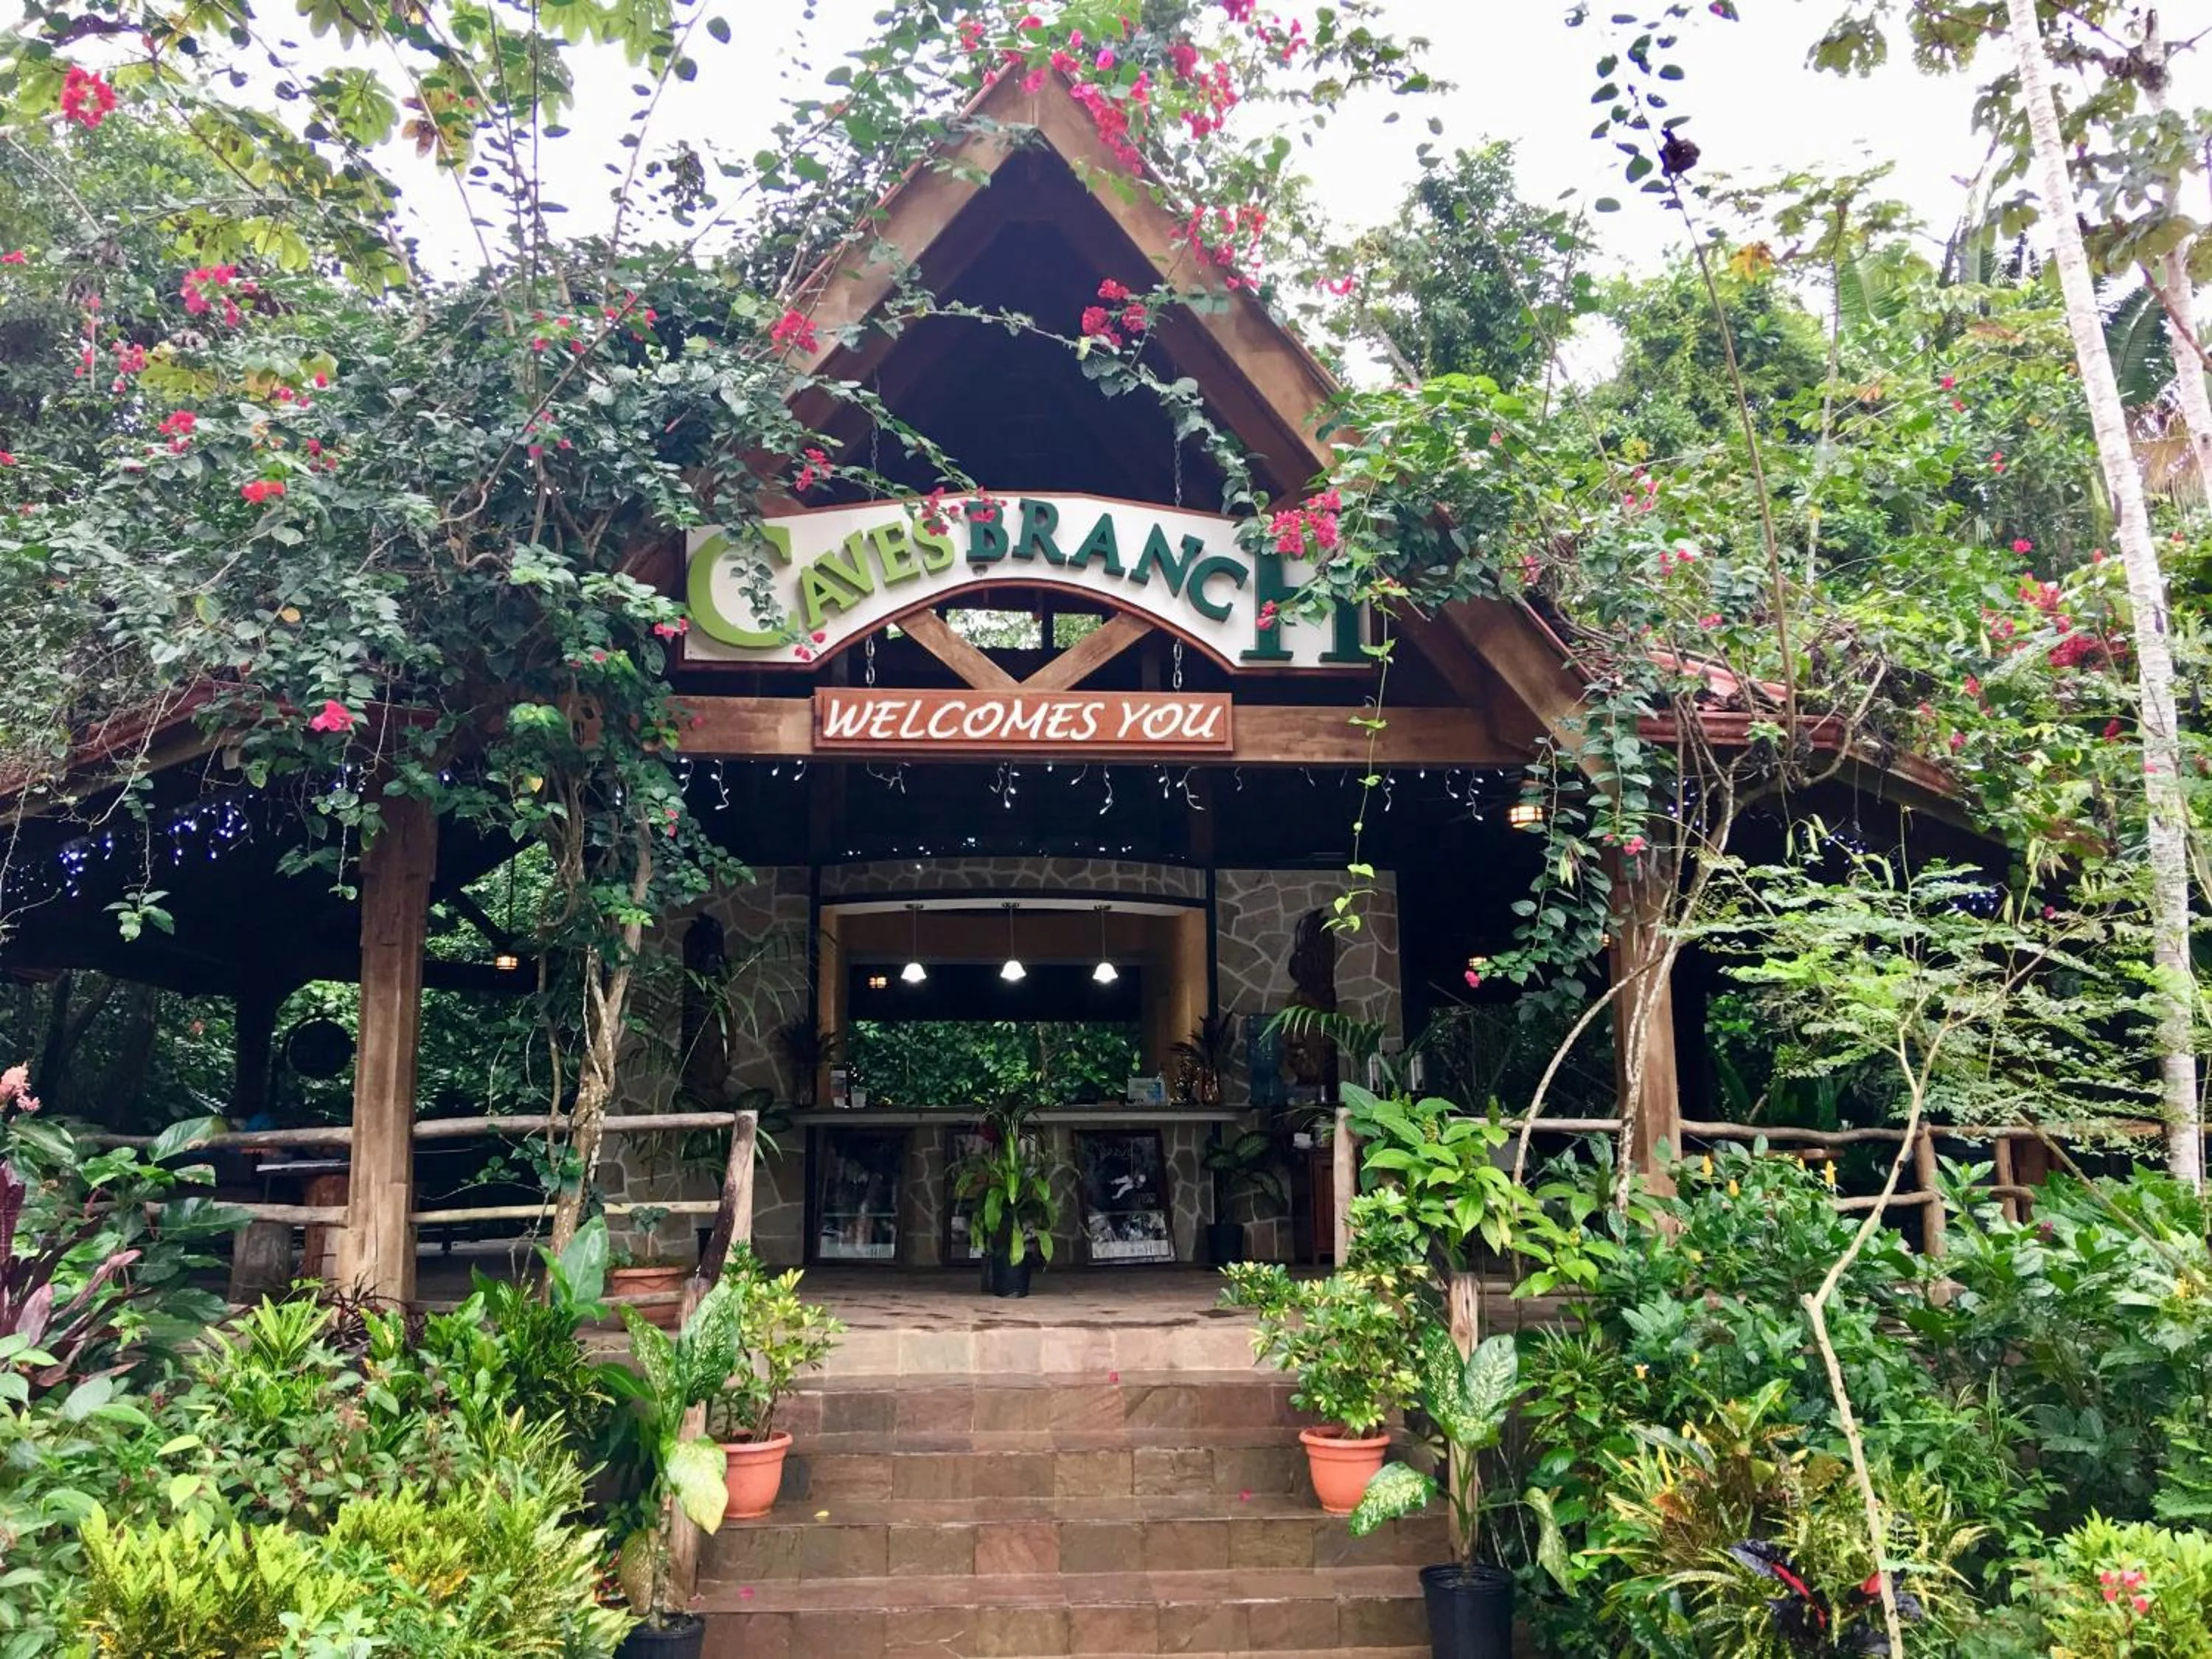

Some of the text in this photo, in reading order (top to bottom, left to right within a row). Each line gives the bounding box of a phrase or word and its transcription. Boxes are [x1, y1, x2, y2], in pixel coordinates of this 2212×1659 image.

[687, 498, 1370, 663] CAVES BRANCH
[824, 698, 1222, 741] WELCOMES YOU
